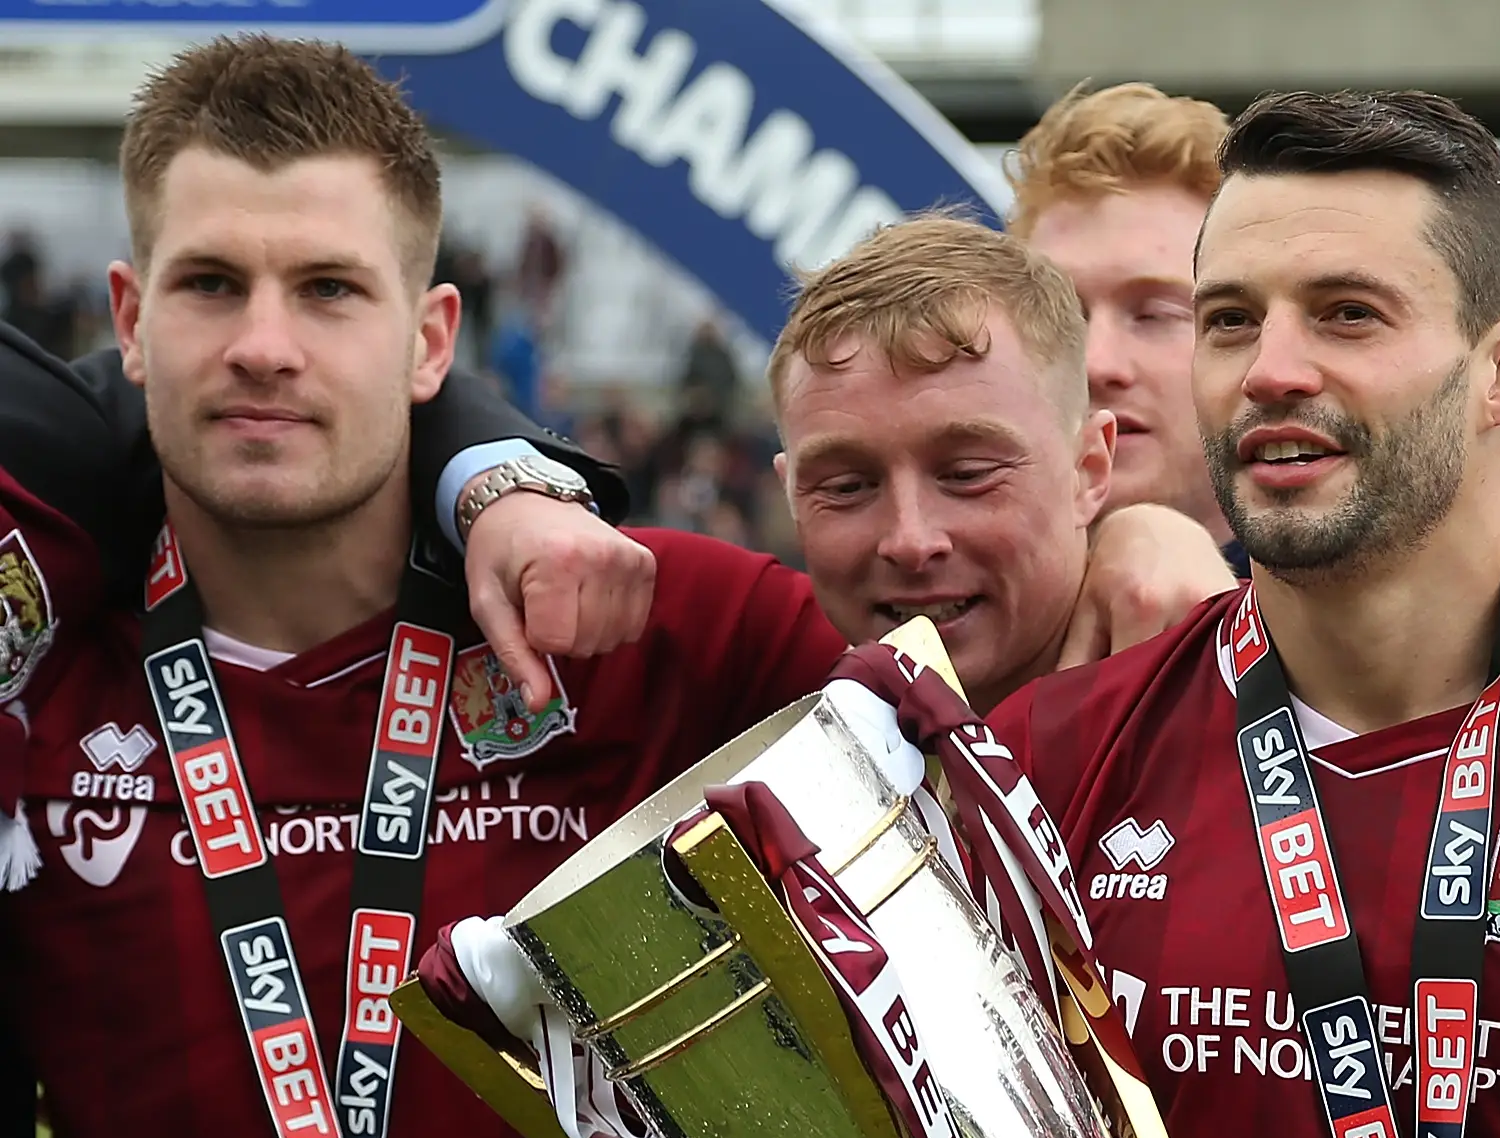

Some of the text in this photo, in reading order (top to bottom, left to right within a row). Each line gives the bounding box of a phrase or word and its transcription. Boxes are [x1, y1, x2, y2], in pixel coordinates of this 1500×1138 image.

[72, 770, 156, 802] errea
[162, 656, 251, 856] sky BET
[376, 638, 441, 844] sky BET
[1432, 699, 1497, 906] sky BET
[1090, 872, 1168, 900] errea
[1252, 727, 1336, 930] sky BET
[239, 934, 329, 1134] sky BET
[340, 925, 401, 1136] sky BET
[1161, 987, 1251, 1028] THE
[1162, 1034, 1221, 1073] OF
[1321, 1014, 1373, 1100] sky
[1426, 994, 1468, 1111] BET
